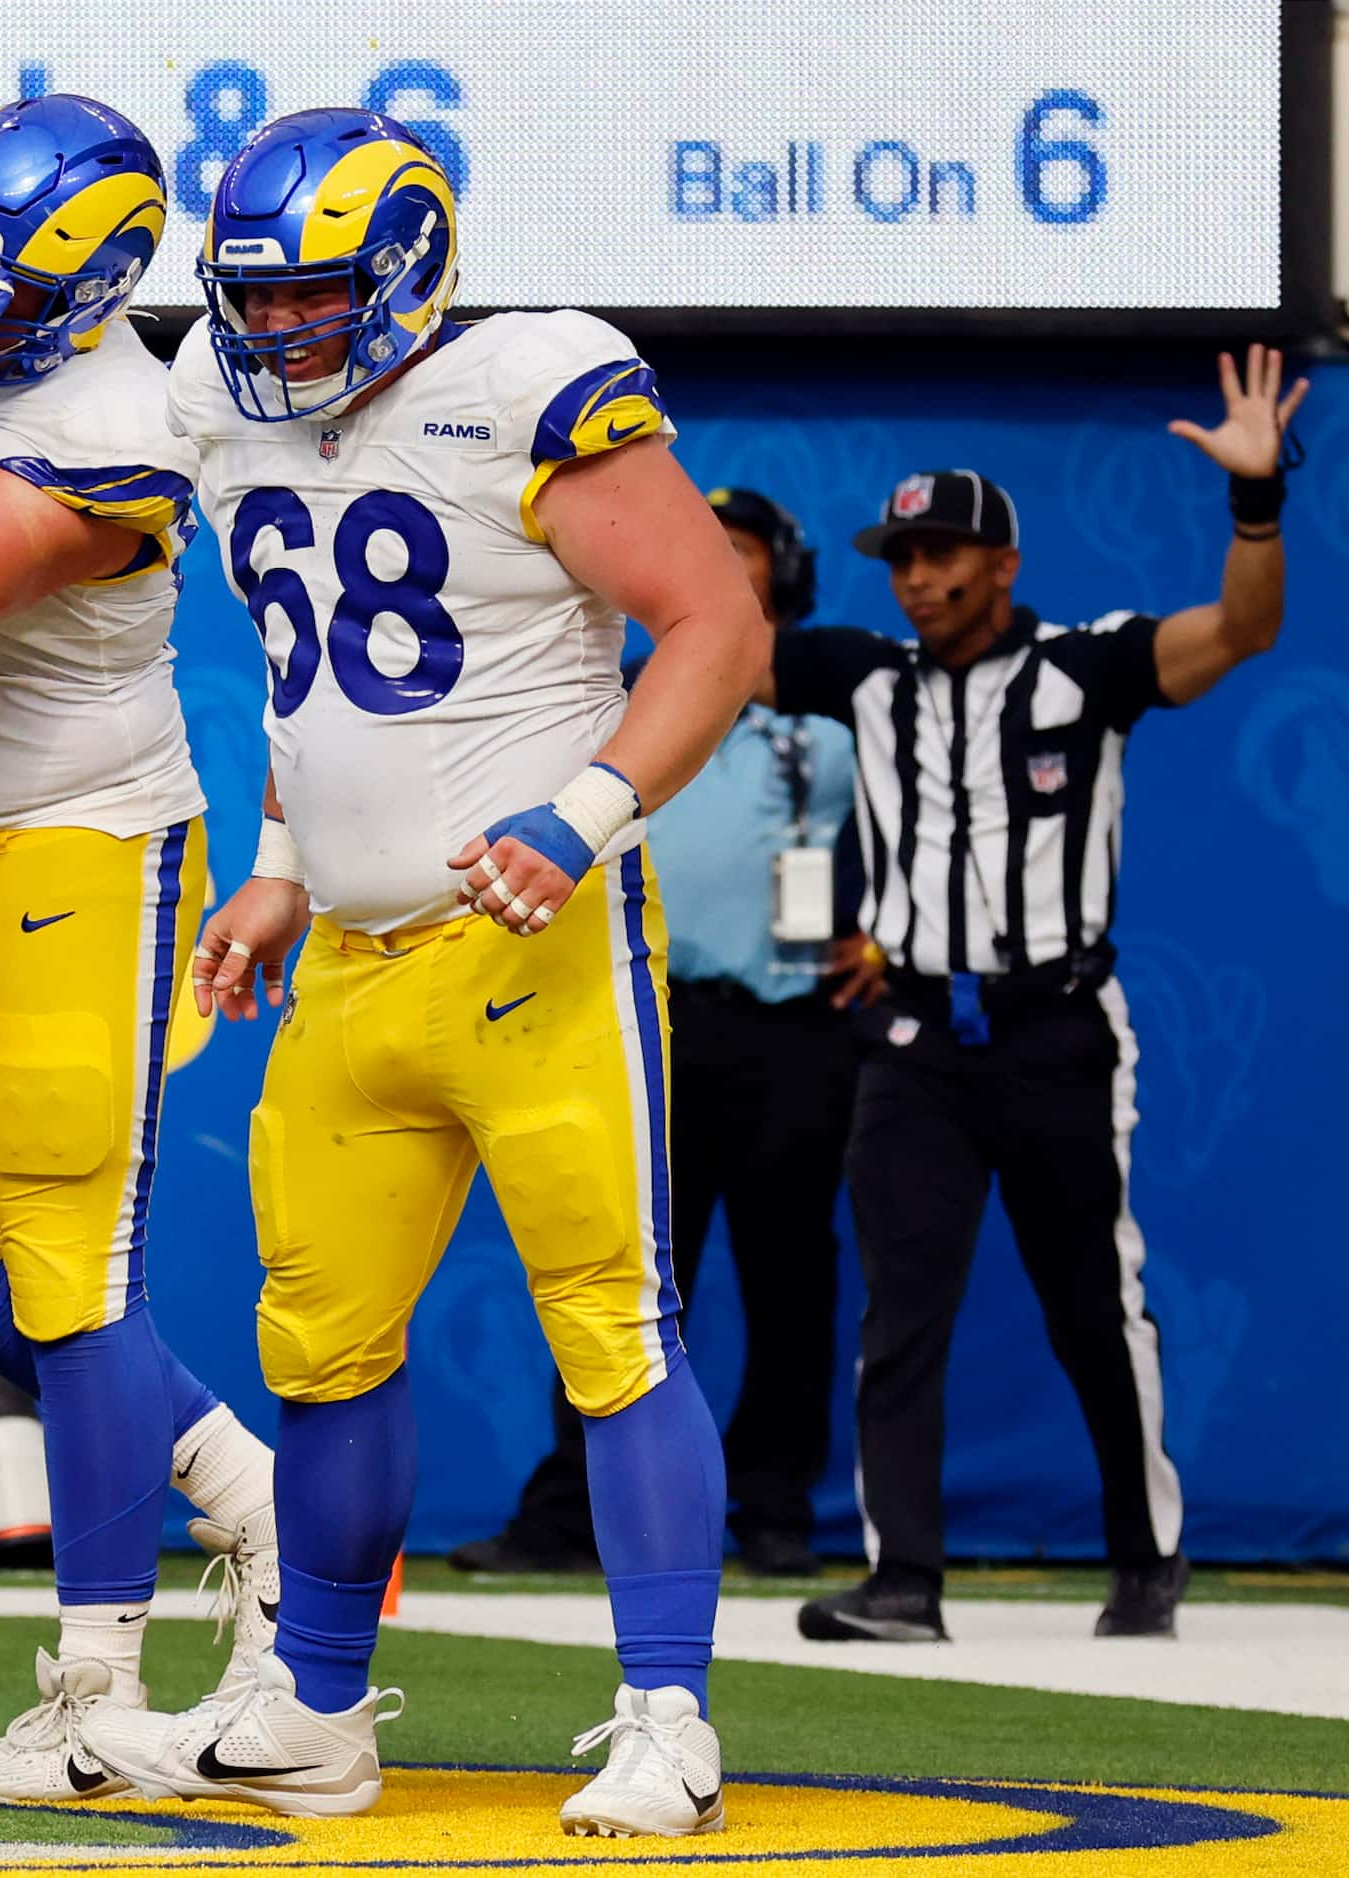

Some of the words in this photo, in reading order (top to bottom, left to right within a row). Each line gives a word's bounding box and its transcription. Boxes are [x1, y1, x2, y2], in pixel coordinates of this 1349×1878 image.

[669, 140, 825, 222] Ball
[853, 140, 975, 223] On
[1015, 88, 1107, 226] 6
[423, 422, 491, 440] RAMS
[230, 485, 464, 719] 68
